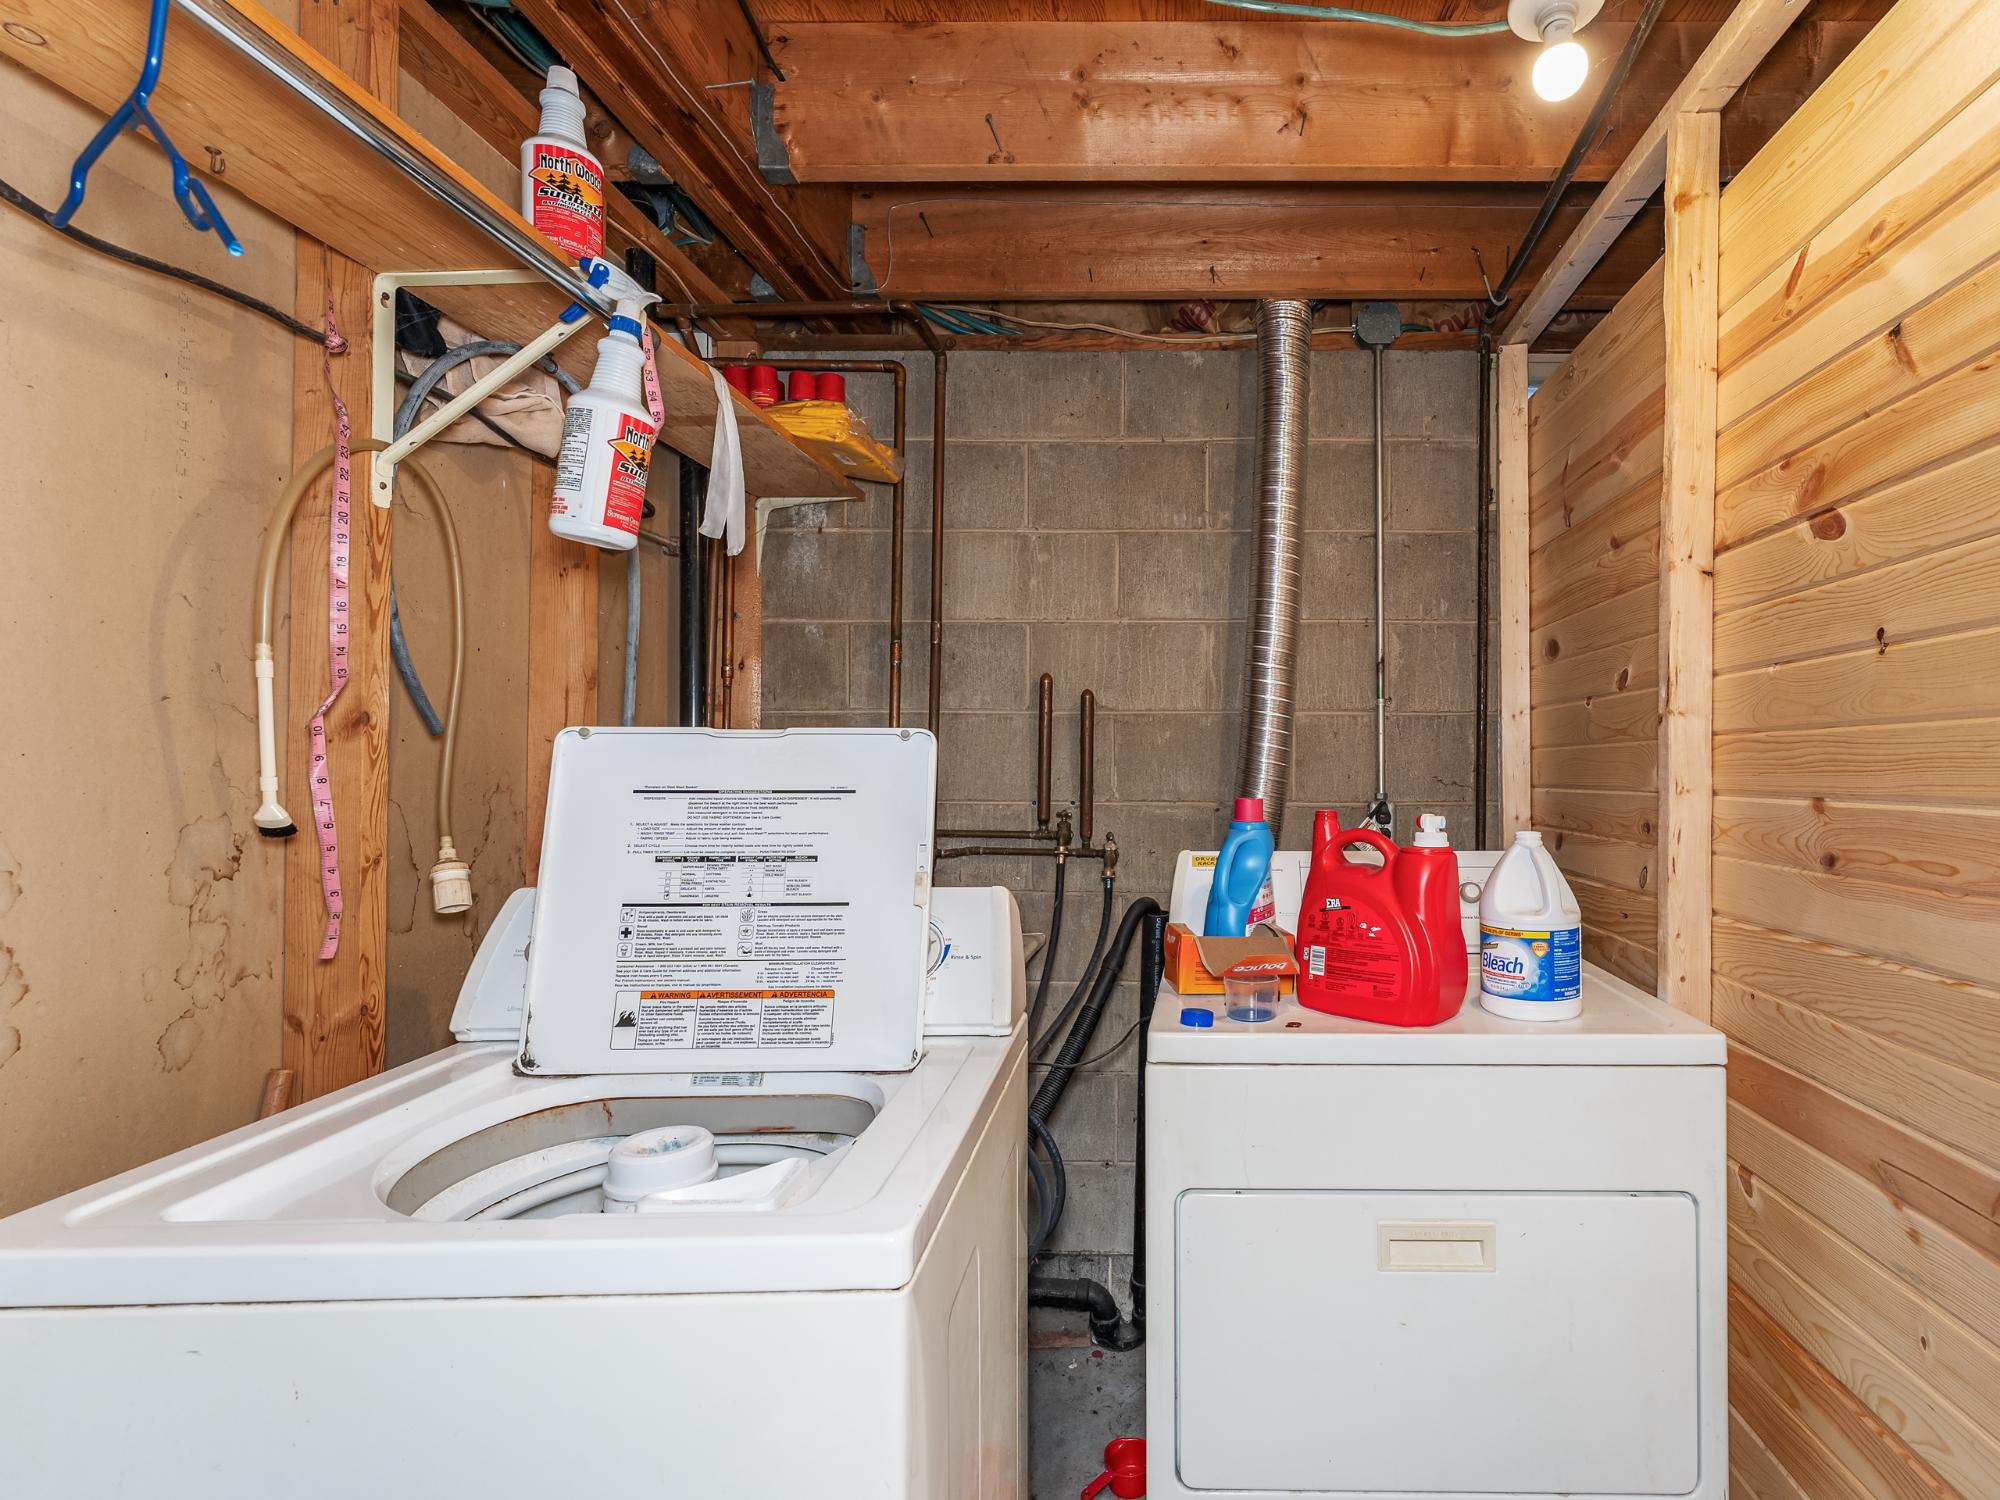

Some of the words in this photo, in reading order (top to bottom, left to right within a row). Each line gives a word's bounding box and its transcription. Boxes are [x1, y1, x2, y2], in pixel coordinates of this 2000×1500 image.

[540, 154, 572, 174] North
[645, 369, 654, 382] 53
[648, 390, 657, 402] 54
[652, 411, 662, 422] 55
[340, 424, 350, 438] 24
[340, 446, 348, 459] 23
[340, 468, 348, 481] 22
[338, 491, 348, 503] 21
[338, 512, 348, 524] 20
[337, 534, 348, 544] 19
[336, 556, 346, 566] 18
[336, 578, 346, 589] 17
[336, 601, 346, 612] 16
[337, 624, 346, 634] 15
[336, 646, 346, 656] 14
[338, 668, 347, 678] 13
[314, 726, 322, 736] 10
[1483, 952, 1524, 974] Bleach
